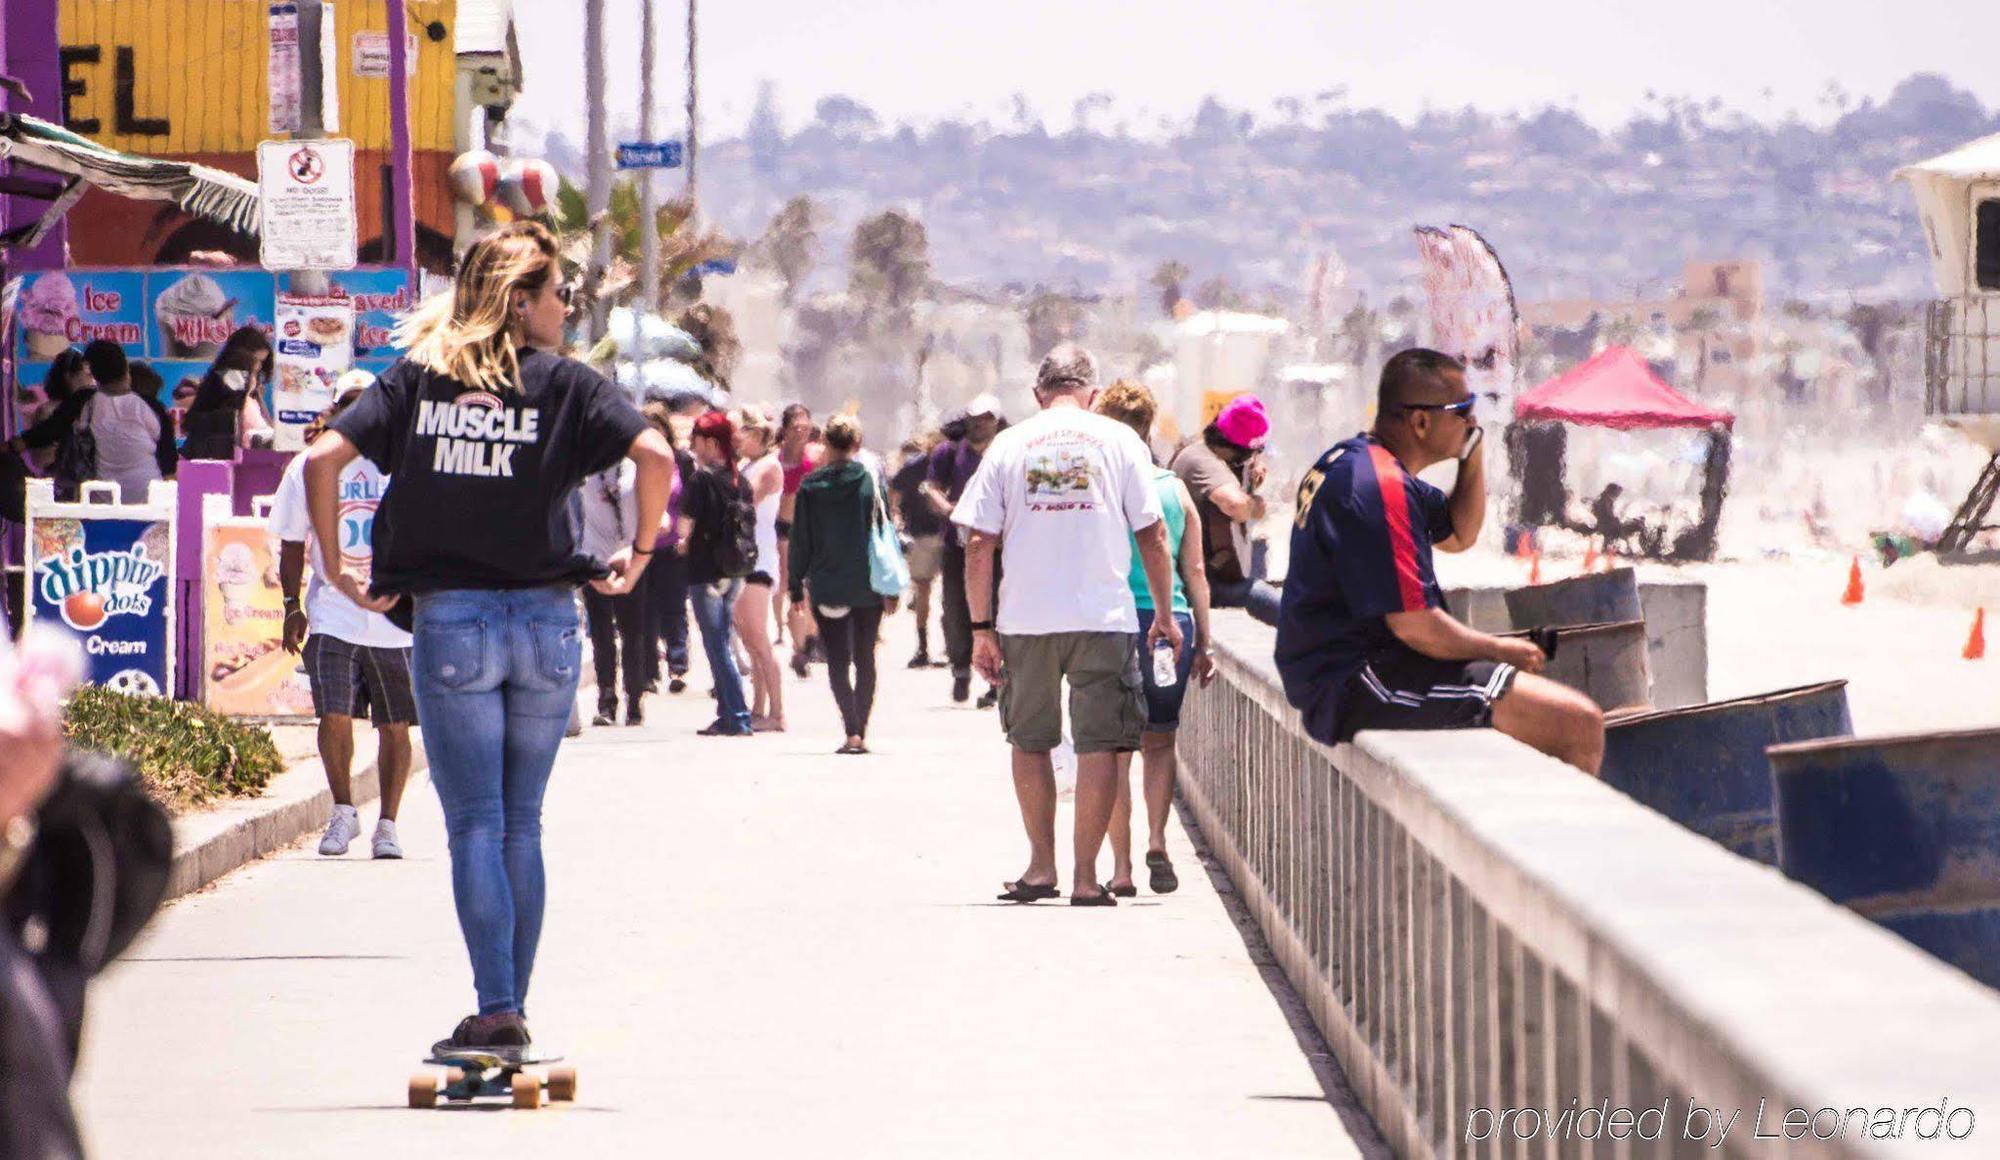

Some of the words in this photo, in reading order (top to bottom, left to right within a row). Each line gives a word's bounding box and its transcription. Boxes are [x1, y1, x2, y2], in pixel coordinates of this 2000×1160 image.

[84, 285, 122, 313] Ice
[64, 316, 140, 344] Cream
[357, 321, 390, 348] Ice
[416, 400, 539, 443] MUSCLE
[433, 437, 515, 477] MILK
[103, 592, 148, 613] dots
[86, 635, 147, 654] Cream
